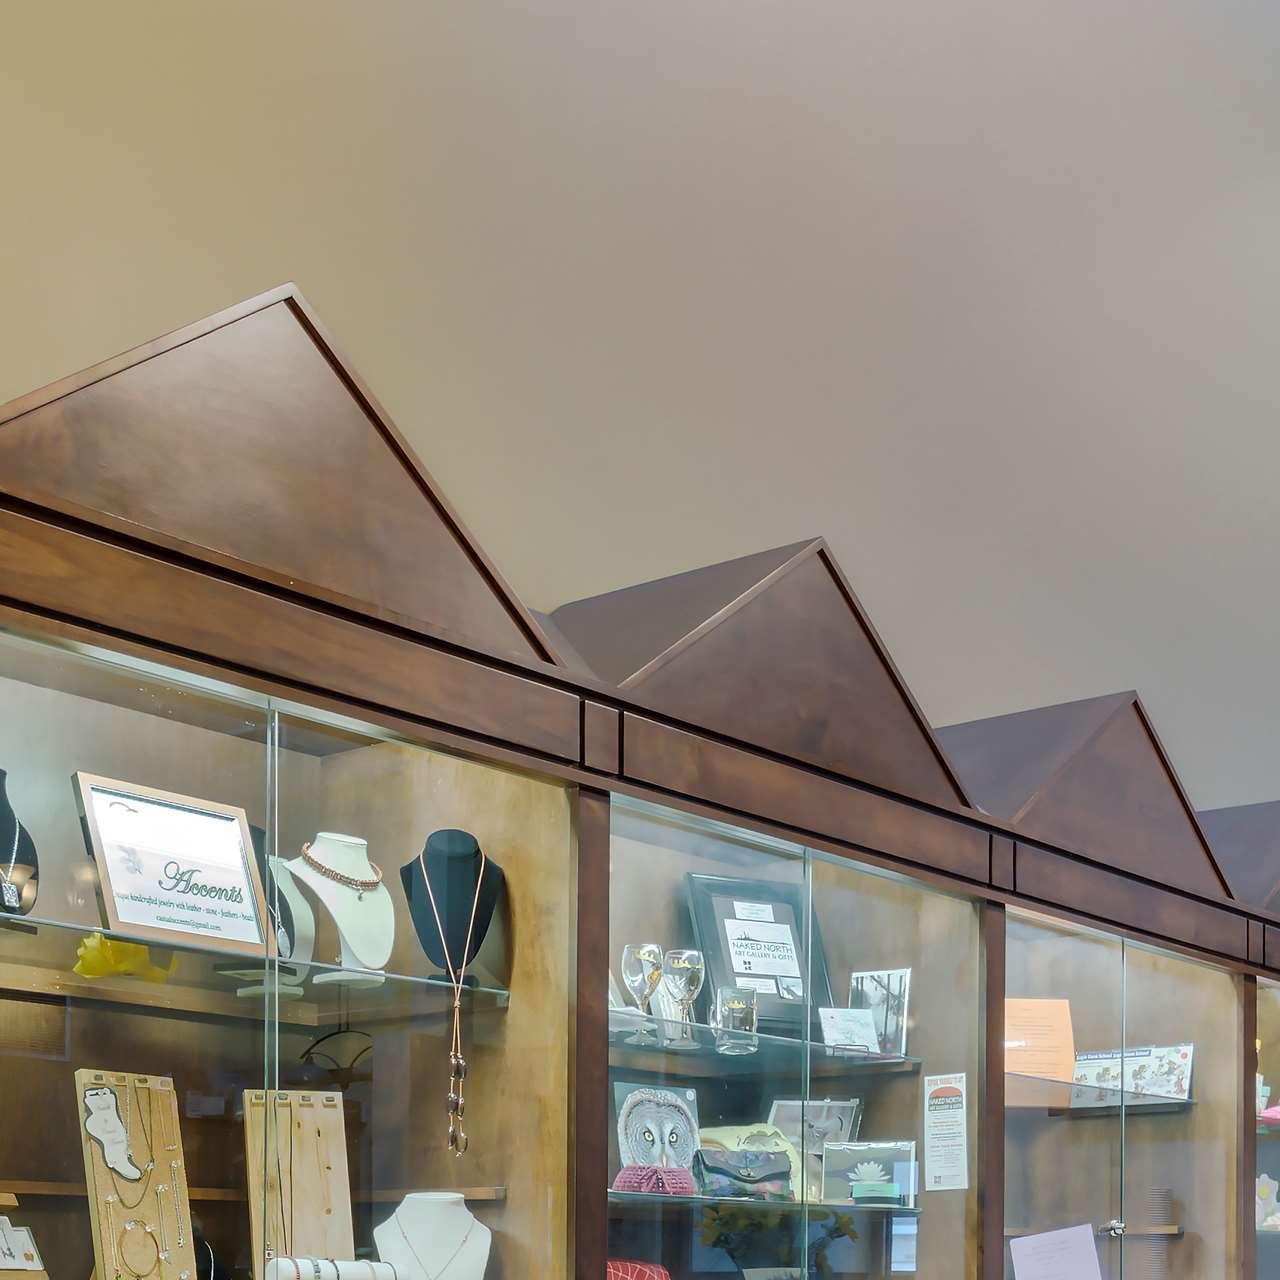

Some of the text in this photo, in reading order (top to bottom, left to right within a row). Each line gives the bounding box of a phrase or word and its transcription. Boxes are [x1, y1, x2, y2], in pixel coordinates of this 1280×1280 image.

[158, 861, 244, 904] Accents
[732, 941, 793, 955] NAKED NORTH
